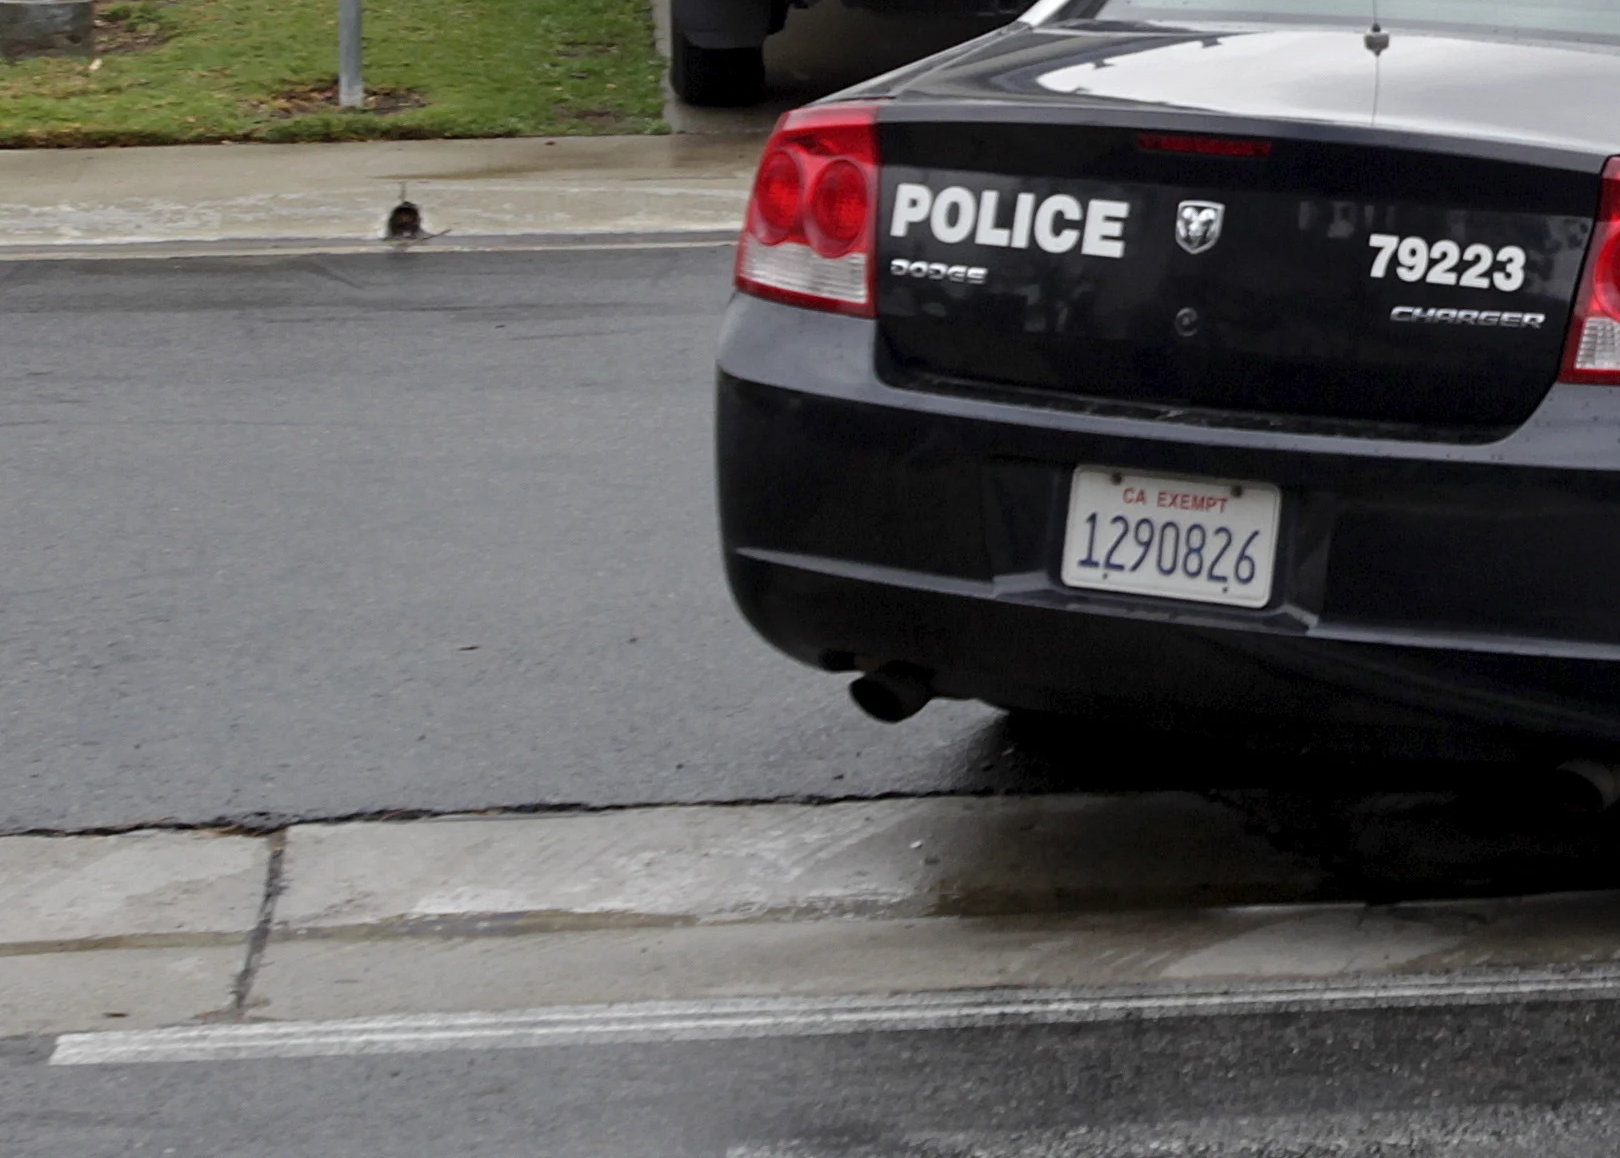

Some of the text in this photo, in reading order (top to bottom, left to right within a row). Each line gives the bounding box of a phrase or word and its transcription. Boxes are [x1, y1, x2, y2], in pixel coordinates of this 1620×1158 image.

[890, 183, 1130, 258] POLICE
[890, 258, 988, 284] DODGE
[1368, 233, 1527, 292] 79223
[1390, 305, 1545, 329] CHARGER
[1123, 487, 1229, 513] CA EXEMPT
[1078, 512, 1260, 584] 1290826
